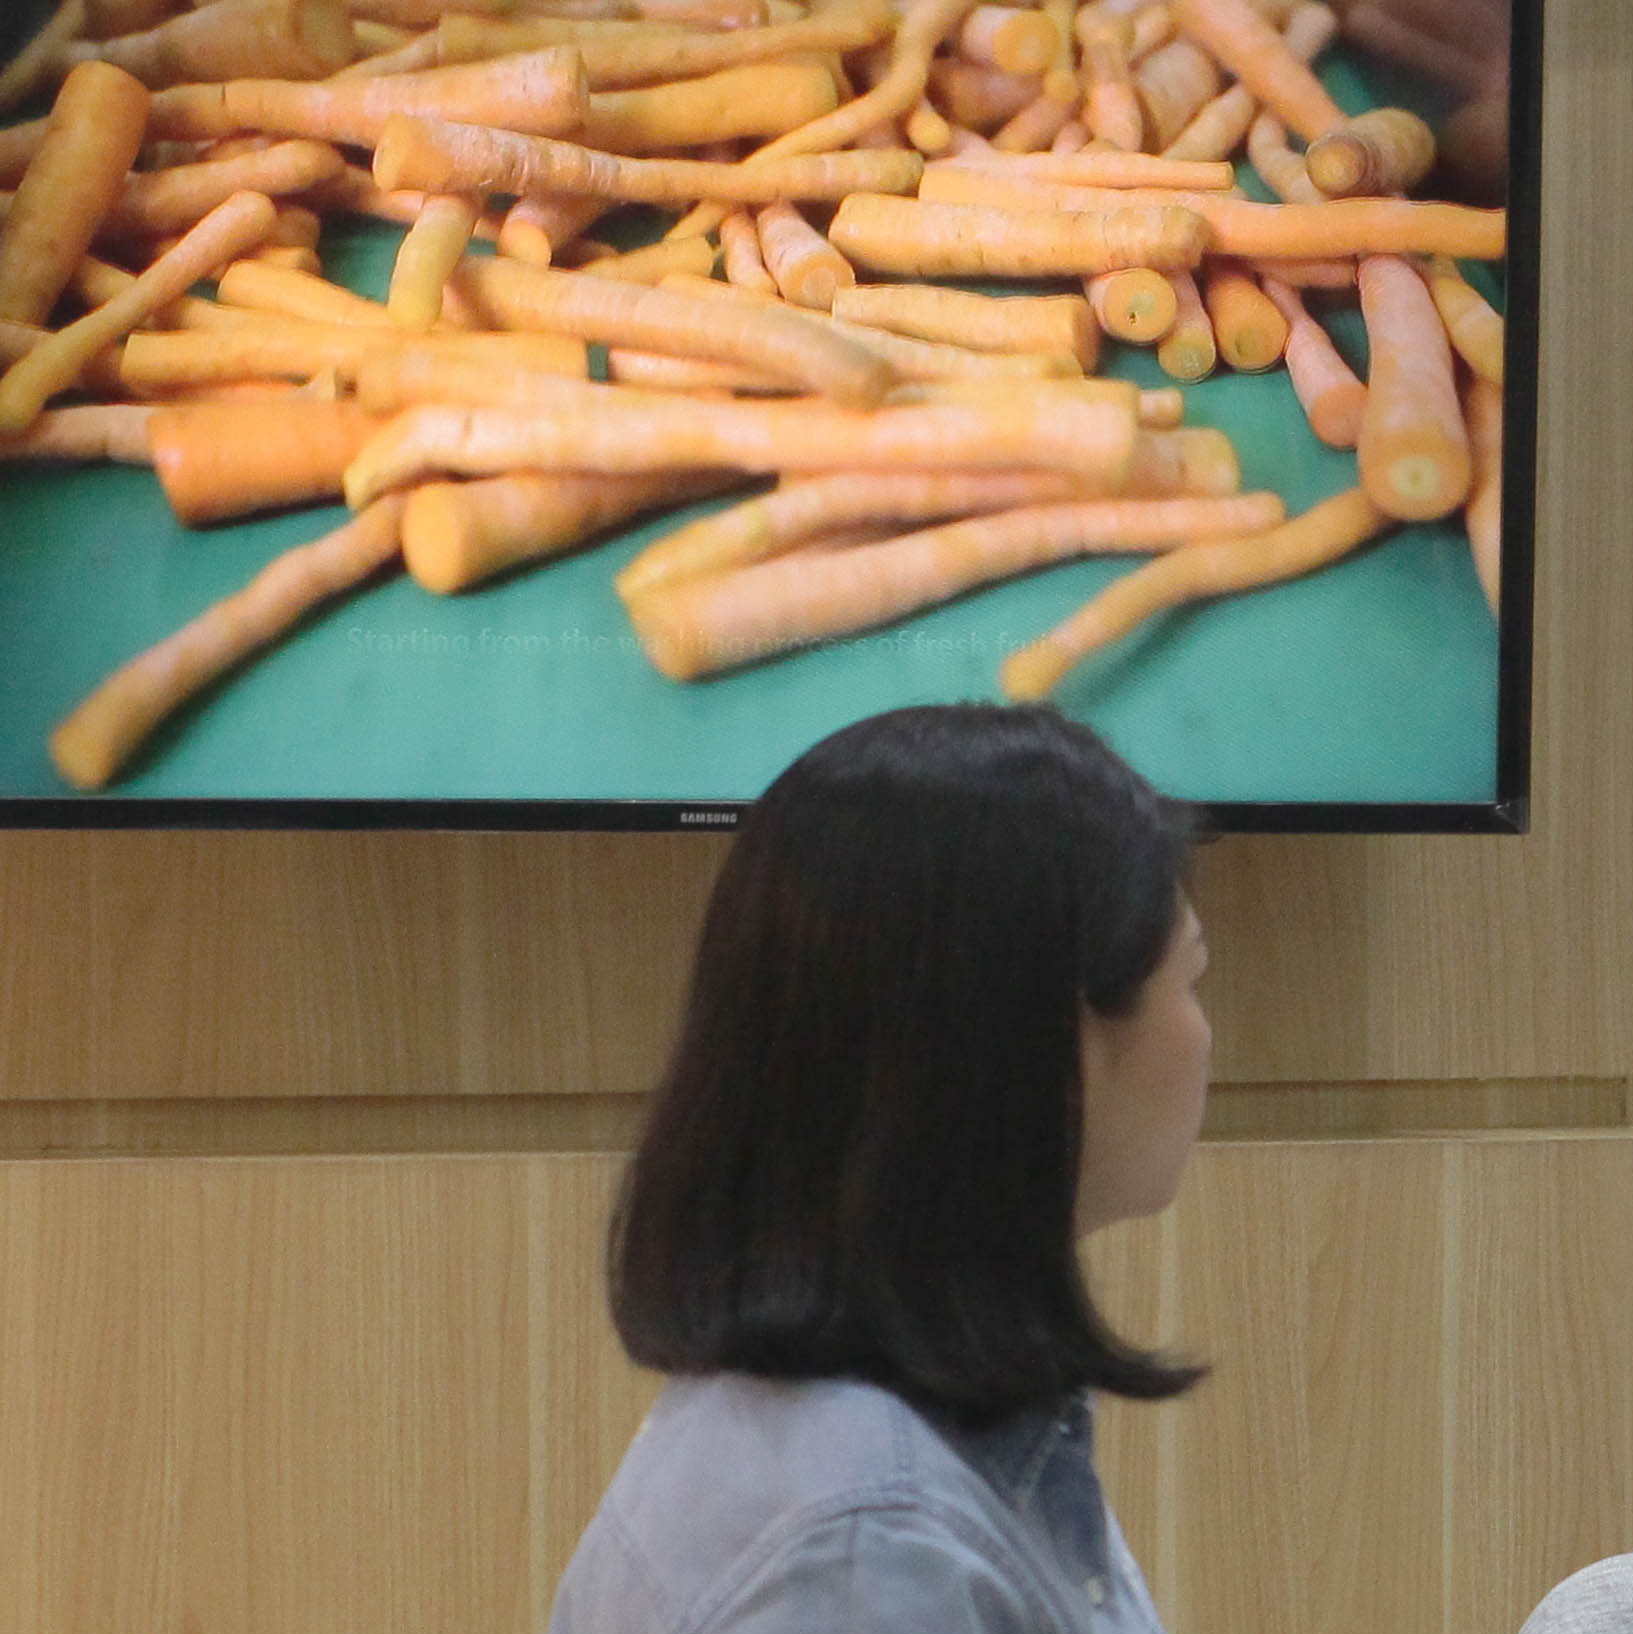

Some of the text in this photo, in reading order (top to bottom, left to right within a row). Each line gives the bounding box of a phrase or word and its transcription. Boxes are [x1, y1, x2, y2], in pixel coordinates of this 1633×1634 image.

[346, 627, 470, 657] Starting
[478, 627, 550, 654] from
[560, 627, 609, 653] the
[914, 629, 988, 652] fresh
[680, 812, 738, 824] SAMSUNG
